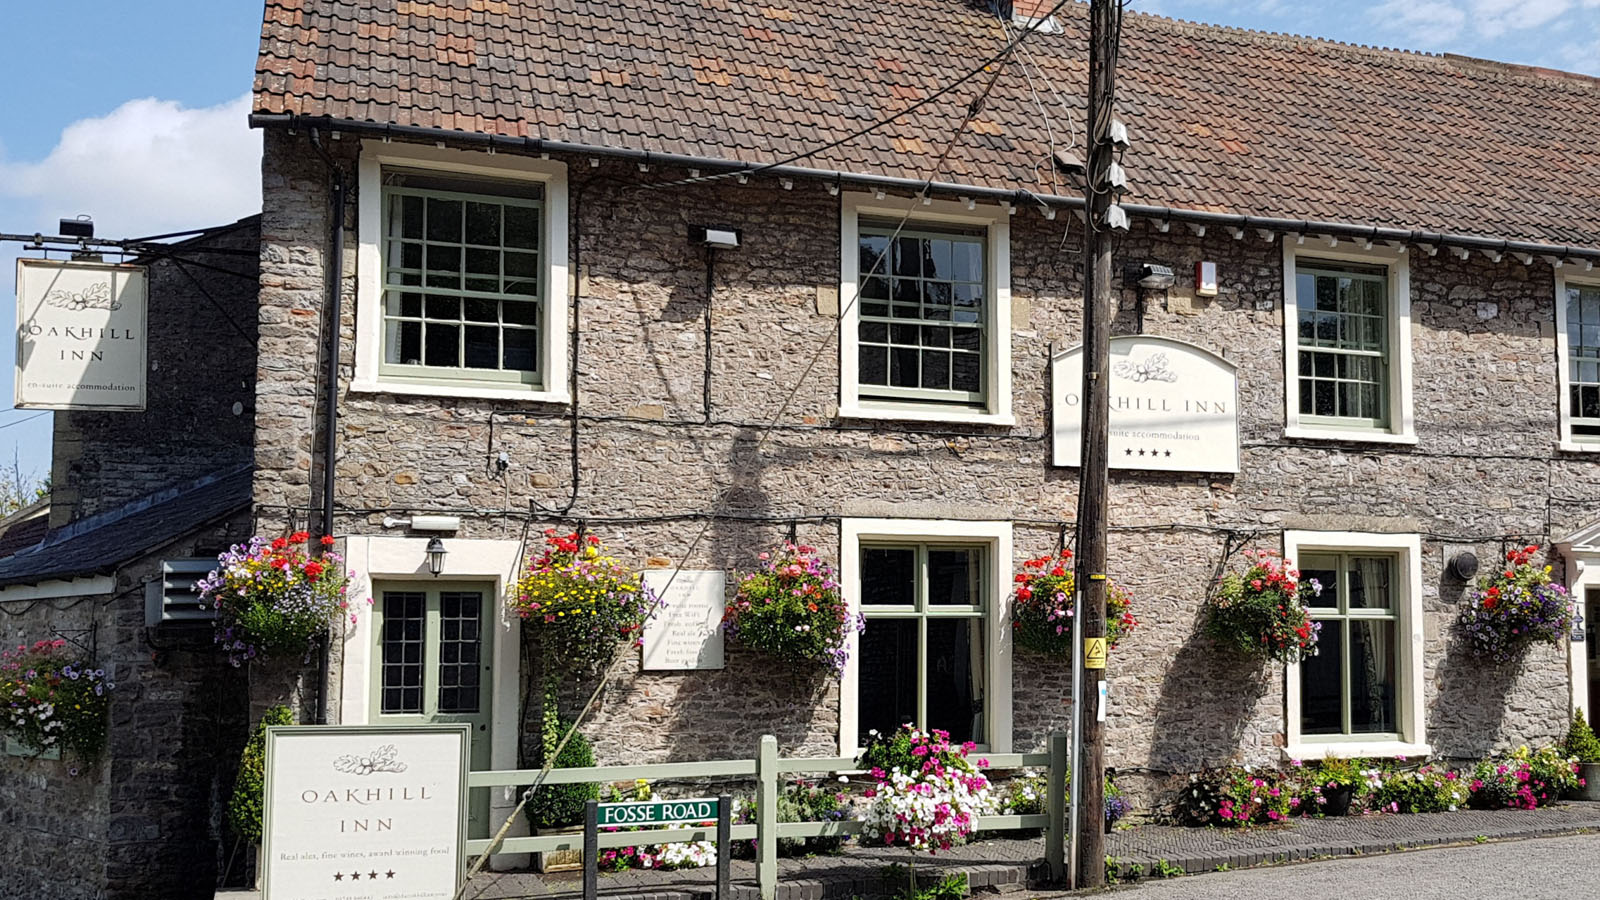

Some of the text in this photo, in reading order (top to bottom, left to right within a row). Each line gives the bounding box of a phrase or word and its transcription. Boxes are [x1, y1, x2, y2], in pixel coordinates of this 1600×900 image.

[28, 325, 135, 341] OAKHILL
[60, 350, 104, 361] INN
[66, 382, 136, 392] accommodation
[1065, 393, 1226, 414] OHILL INN
[1132, 431, 1200, 441] accommodation
[301, 786, 433, 806] OAKHILL
[605, 803, 711, 823] FOSSE ROAD
[340, 818, 393, 833] INN
[280, 852, 299, 861] Real
[321, 851, 337, 859] fine
[368, 848, 393, 857] award
[395, 847, 429, 857] winning
[430, 845, 450, 855] food
